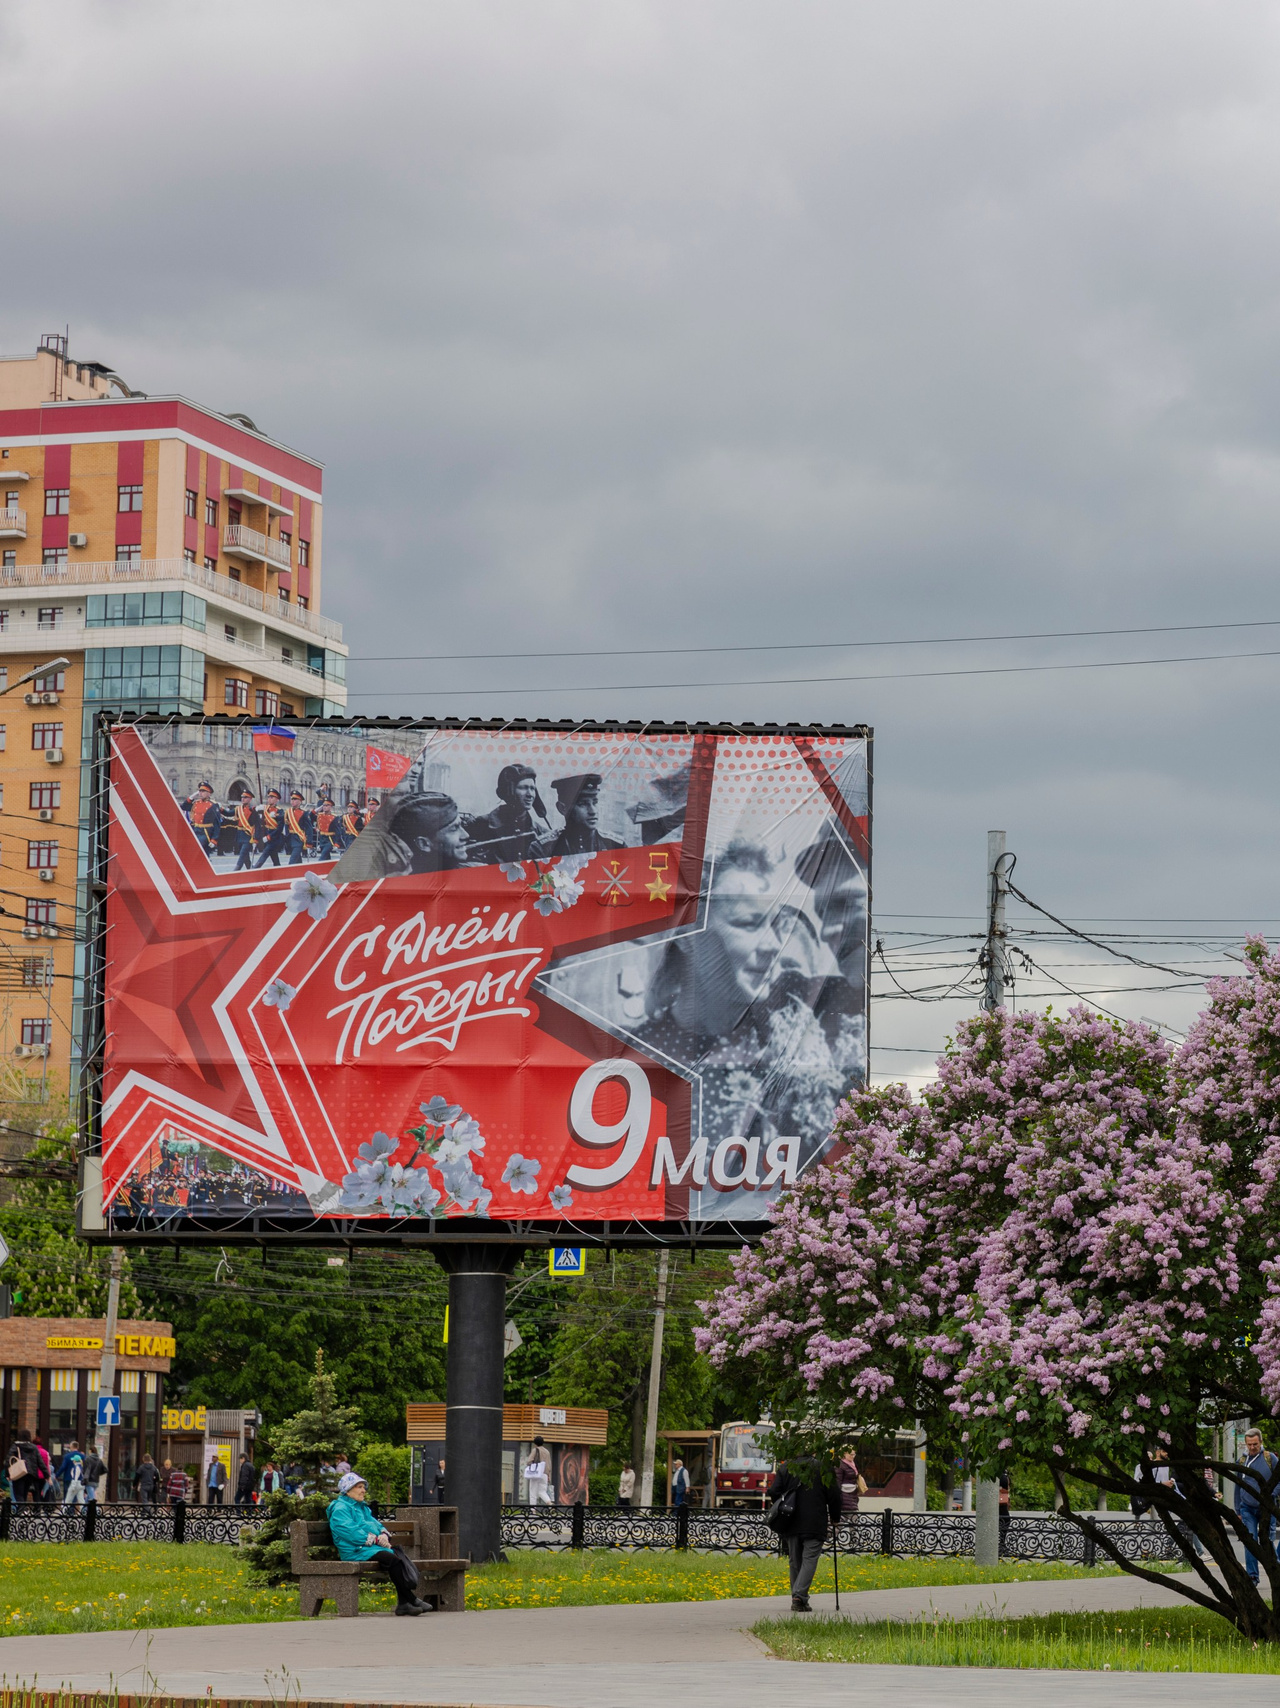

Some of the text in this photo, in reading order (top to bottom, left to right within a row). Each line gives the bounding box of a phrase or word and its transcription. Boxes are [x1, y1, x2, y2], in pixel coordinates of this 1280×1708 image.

[326, 948, 544, 1065] Победы!
[335, 905, 528, 991] С Днём
[564, 1058, 802, 1190] 9 мая
